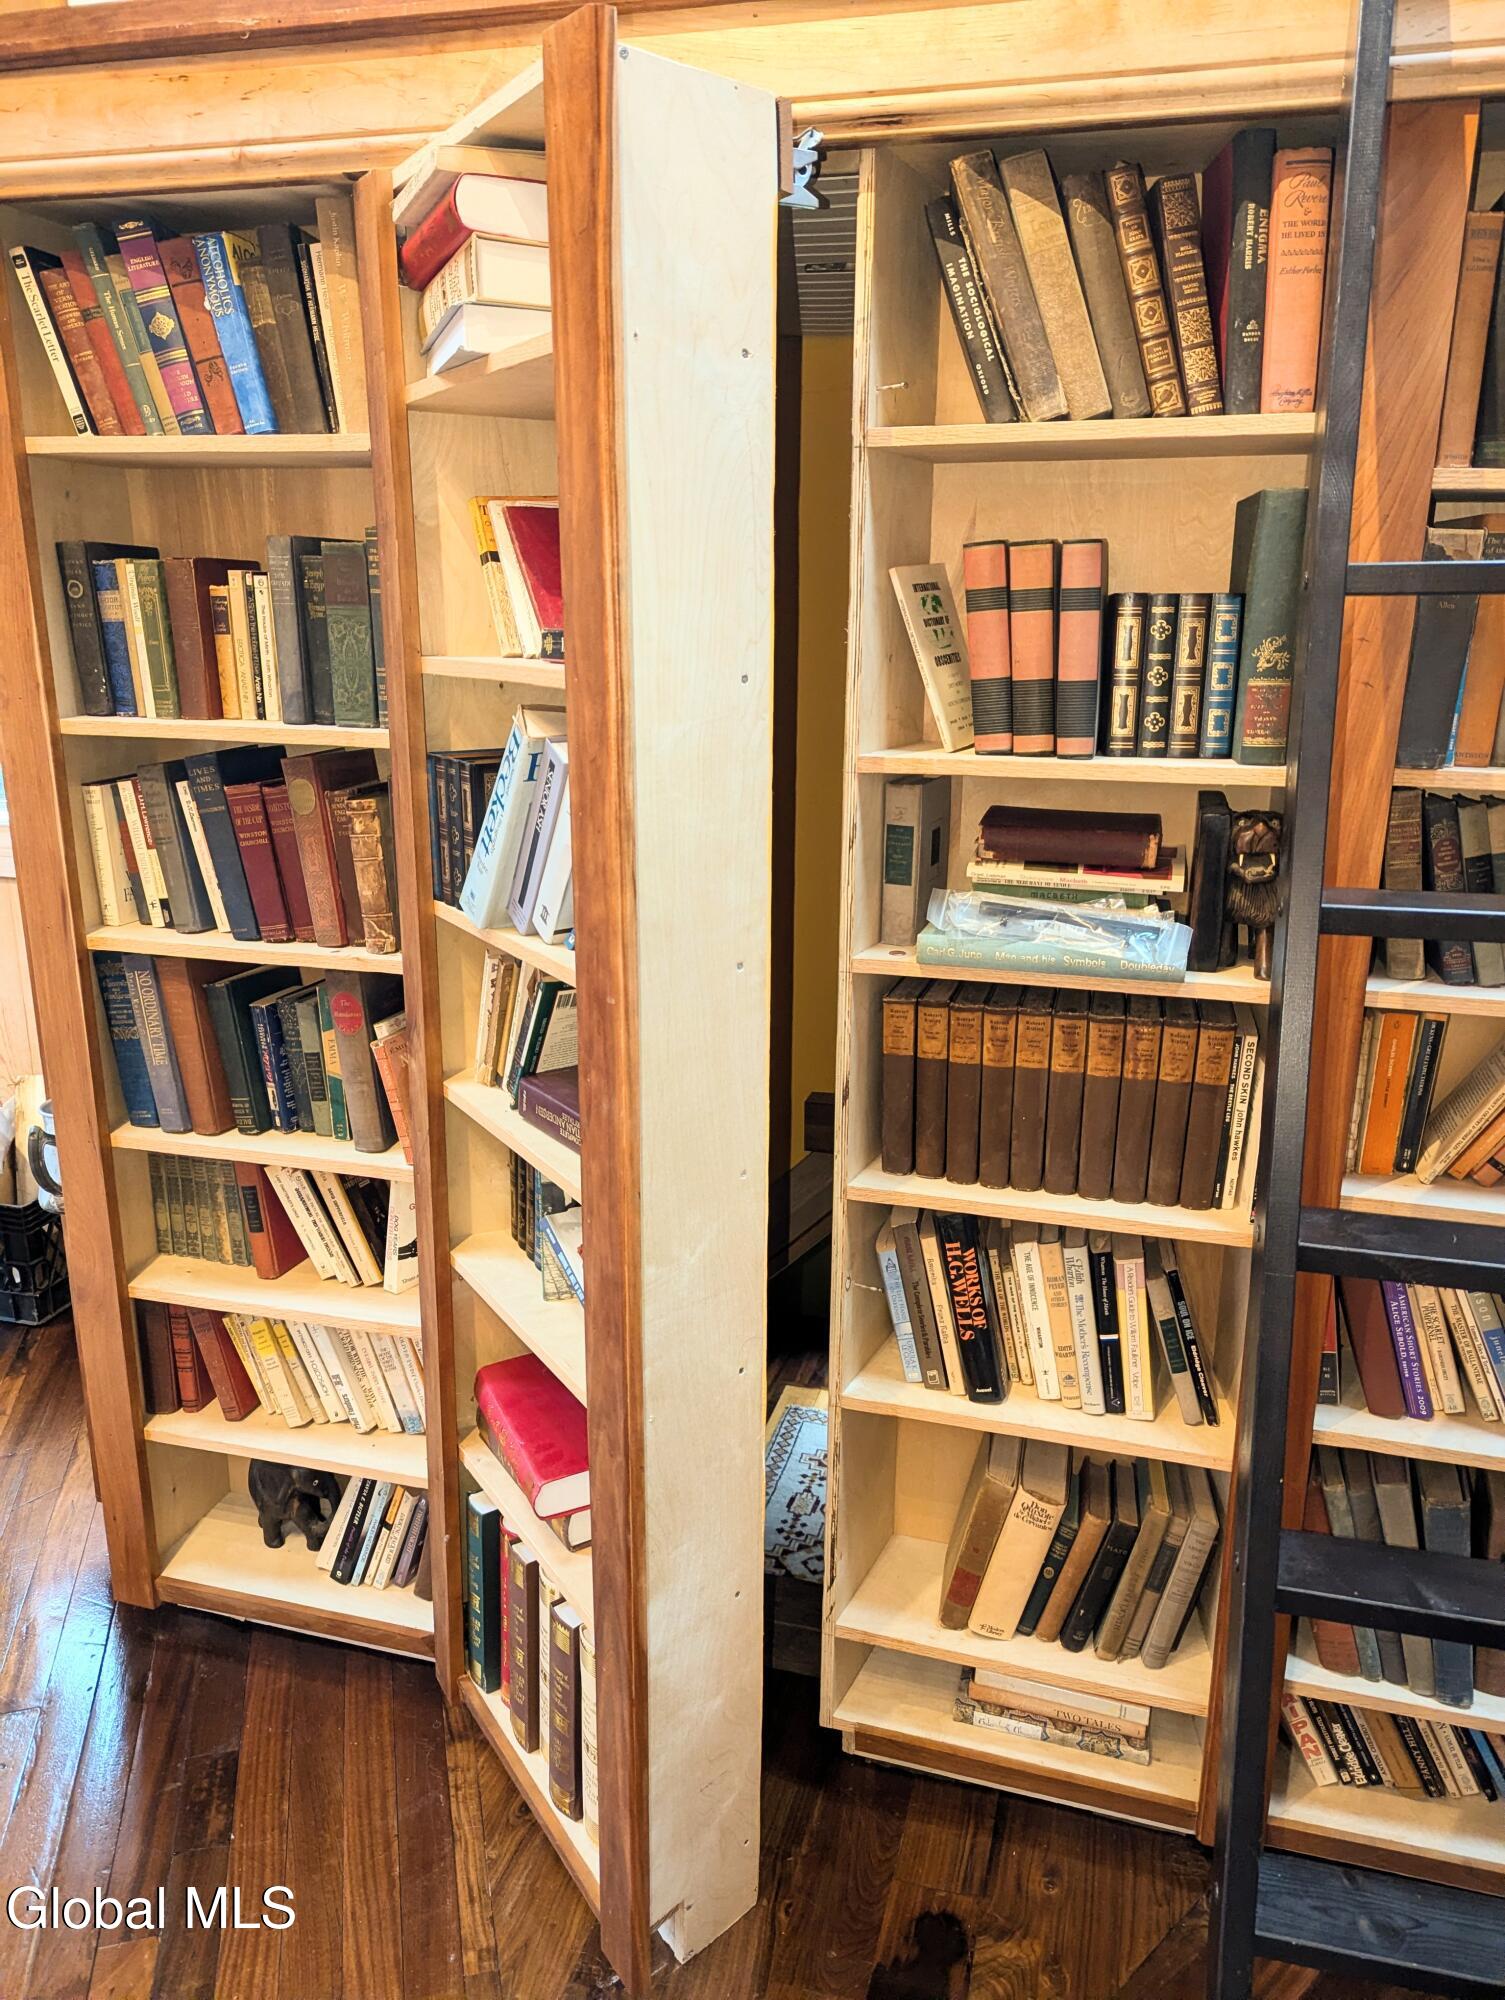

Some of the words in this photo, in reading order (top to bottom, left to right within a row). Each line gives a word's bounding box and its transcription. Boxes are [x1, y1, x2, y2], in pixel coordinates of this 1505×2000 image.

[1289, 172, 1325, 190] Paul
[1285, 189, 1328, 209] Revere
[1246, 203, 1256, 237] ROBERT
[1282, 220, 1299, 228] THE
[1303, 207, 1313, 217] &
[943, 212, 956, 238] MILLS
[1257, 208, 1270, 265] ENIGMA
[128, 260, 160, 272] LITERATURE
[130, 255, 154, 265] ENGLISH
[1244, 238, 1254, 270] HARRIS
[195, 239, 225, 319] ANONYMOUS
[207, 237, 235, 316] ALCOHOLICS
[945, 262, 975, 340] IMAGINATION
[957, 256, 970, 279] THE
[965, 281, 995, 363] SOCIOLOGICAL
[20, 271, 34, 295] The
[27, 293, 49, 331] Scarlet
[42, 329, 60, 363] Letter
[975, 362, 990, 396] OXFORD
[911, 581, 941, 593] INTERNATIONAL
[922, 615, 945, 627] DICTIONARY
[933, 651, 962, 667] OBSCENITIES
[189, 766, 216, 776] LIVES
[196, 775, 212, 784] AND
[191, 783, 221, 794] TIMES
[480, 730, 522, 858] Beckett
[233, 805, 244, 814] THE
[270, 818, 295, 827] WINSTO
[238, 831, 268, 839] WINSTON
[239, 838, 270, 847] CHURCHILL
[1062, 955, 1108, 969] Symbols
[1119, 959, 1176, 976] Doubleday
[138, 970, 153, 986] NO
[141, 988, 164, 1040] ORDINARY
[339, 999, 351, 1007] The
[152, 1042, 168, 1066] TIME
[327, 1038, 337, 1066] EMMA
[1242, 1041, 1255, 1082] SECOND
[1239, 1081, 1250, 1105] SKIN
[535, 1103, 567, 1129] ANDERSEN
[1235, 1109, 1247, 1129] john
[1231, 1129, 1244, 1161] hawkes
[944, 1241, 965, 1279] H.G.
[1024, 1252, 1032, 1263] THE
[1026, 1263, 1034, 1275] AGE
[961, 1247, 984, 1308] WORKS
[1027, 1274, 1036, 1283] OF
[1065, 1256, 1076, 1289] Wharton
[1074, 1258, 1086, 1285] Edith
[1029, 1282, 1040, 1312] INNOCENCE
[1177, 1300, 1189, 1318] SOUL
[1428, 1301, 1438, 1314] THE
[950, 1278, 976, 1342] WELLS
[971, 1306, 989, 1330] OF
[1075, 1304, 1085, 1317] The
[1390, 1300, 1401, 1325] ALICE
[1398, 1293, 1412, 1334] AMERICAN
[1182, 1317, 1192, 1329] ON
[1185, 1328, 1196, 1341] ICE
[1421, 1304, 1437, 1343] PIMPERNEL
[1432, 1313, 1446, 1344] SCARLET
[1405, 1335, 1417, 1361] SHORT
[1450, 1304, 1460, 1316] THE
[1455, 1316, 1468, 1341] MASTER
[1466, 1347, 1484, 1385] BALLANTRAE
[1410, 1361, 1424, 1393] STORIES
[1416, 1394, 1428, 1416] 2009
[352, 1502, 365, 1526] BUTLER
[1021, 1502, 1055, 1520] Quixote
[1030, 1501, 1048, 1514] Don
[1054, 1709, 1082, 1722] TWO
[1082, 1716, 1123, 1733] TALES
[1290, 1717, 1322, 1761] PAN
[1402, 1729, 1418, 1750] HILL
[1373, 1754, 1387, 1776] ANTON
[1412, 1748, 1432, 1780] FANNY
